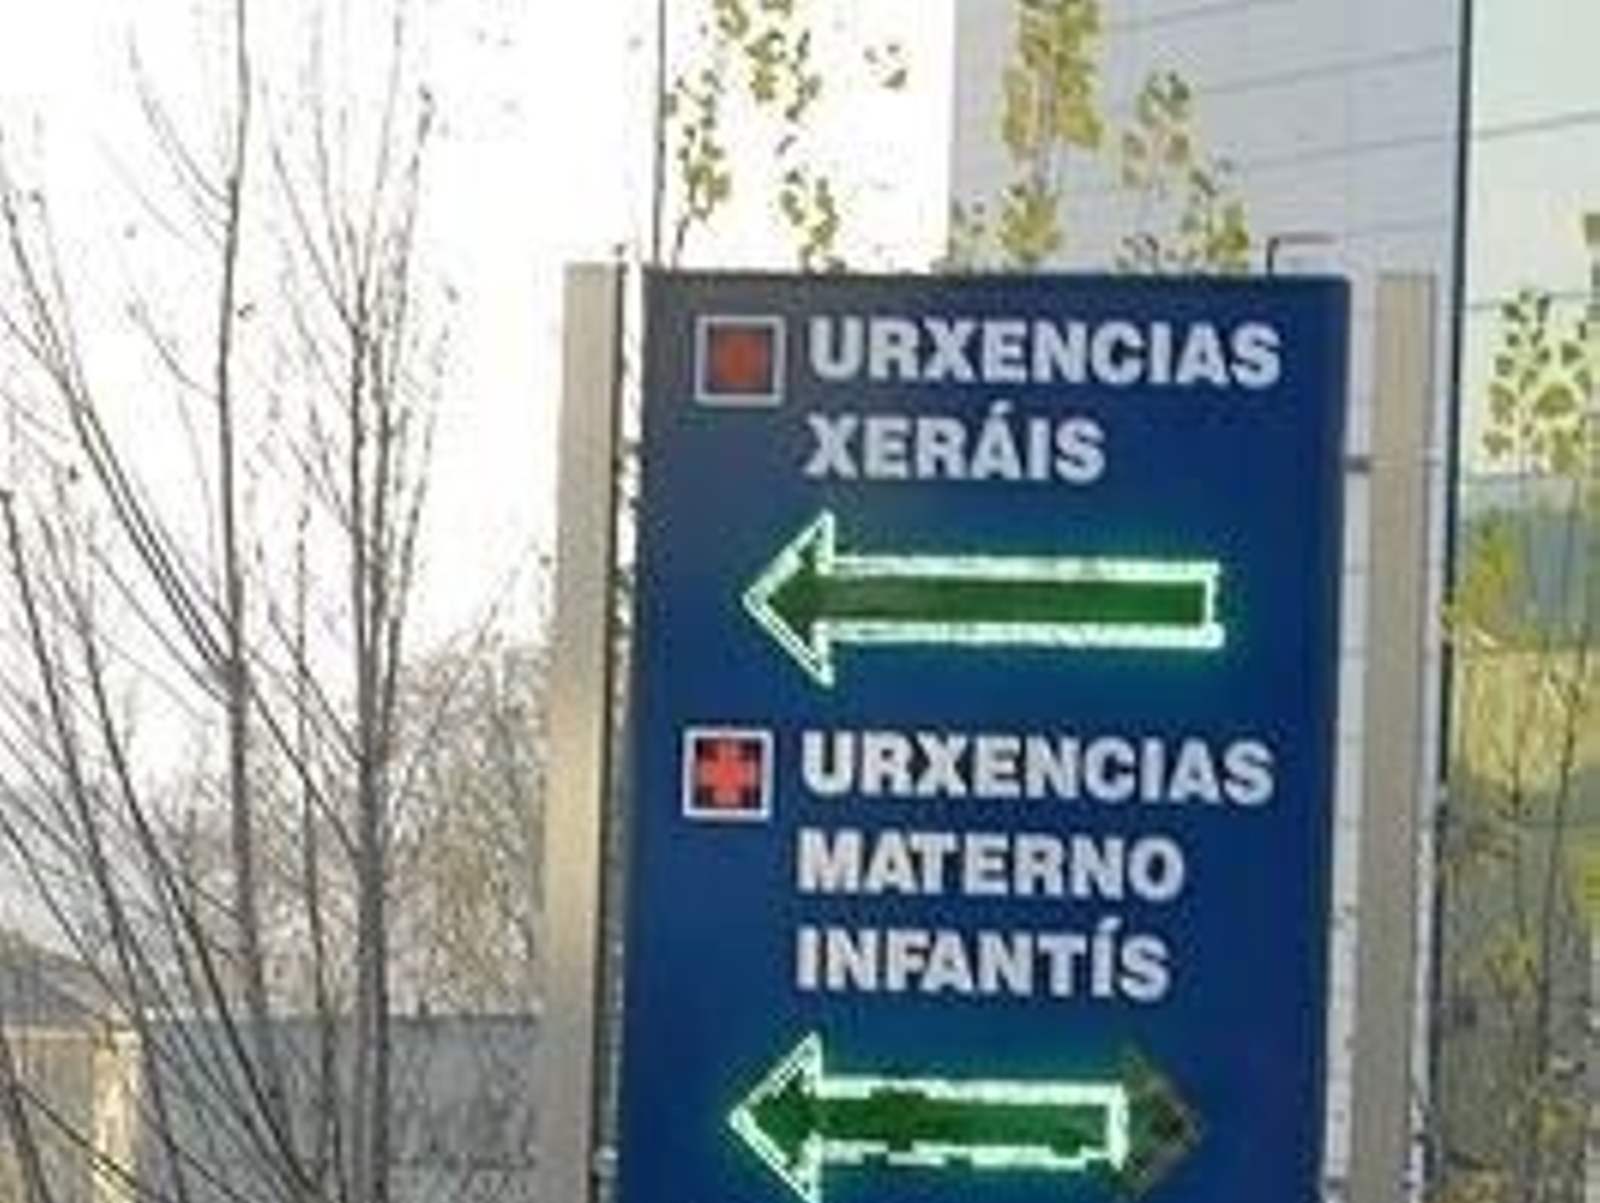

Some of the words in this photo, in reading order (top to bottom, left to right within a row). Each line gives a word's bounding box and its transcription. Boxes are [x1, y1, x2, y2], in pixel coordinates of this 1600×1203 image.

[809, 315, 1280, 386] URXENCIAS
[805, 400, 1105, 482] XERÁIS
[801, 730, 1274, 804] URXENCIAS
[797, 828, 1184, 900] MATERNO
[796, 916, 1168, 999] INFANTÍS
